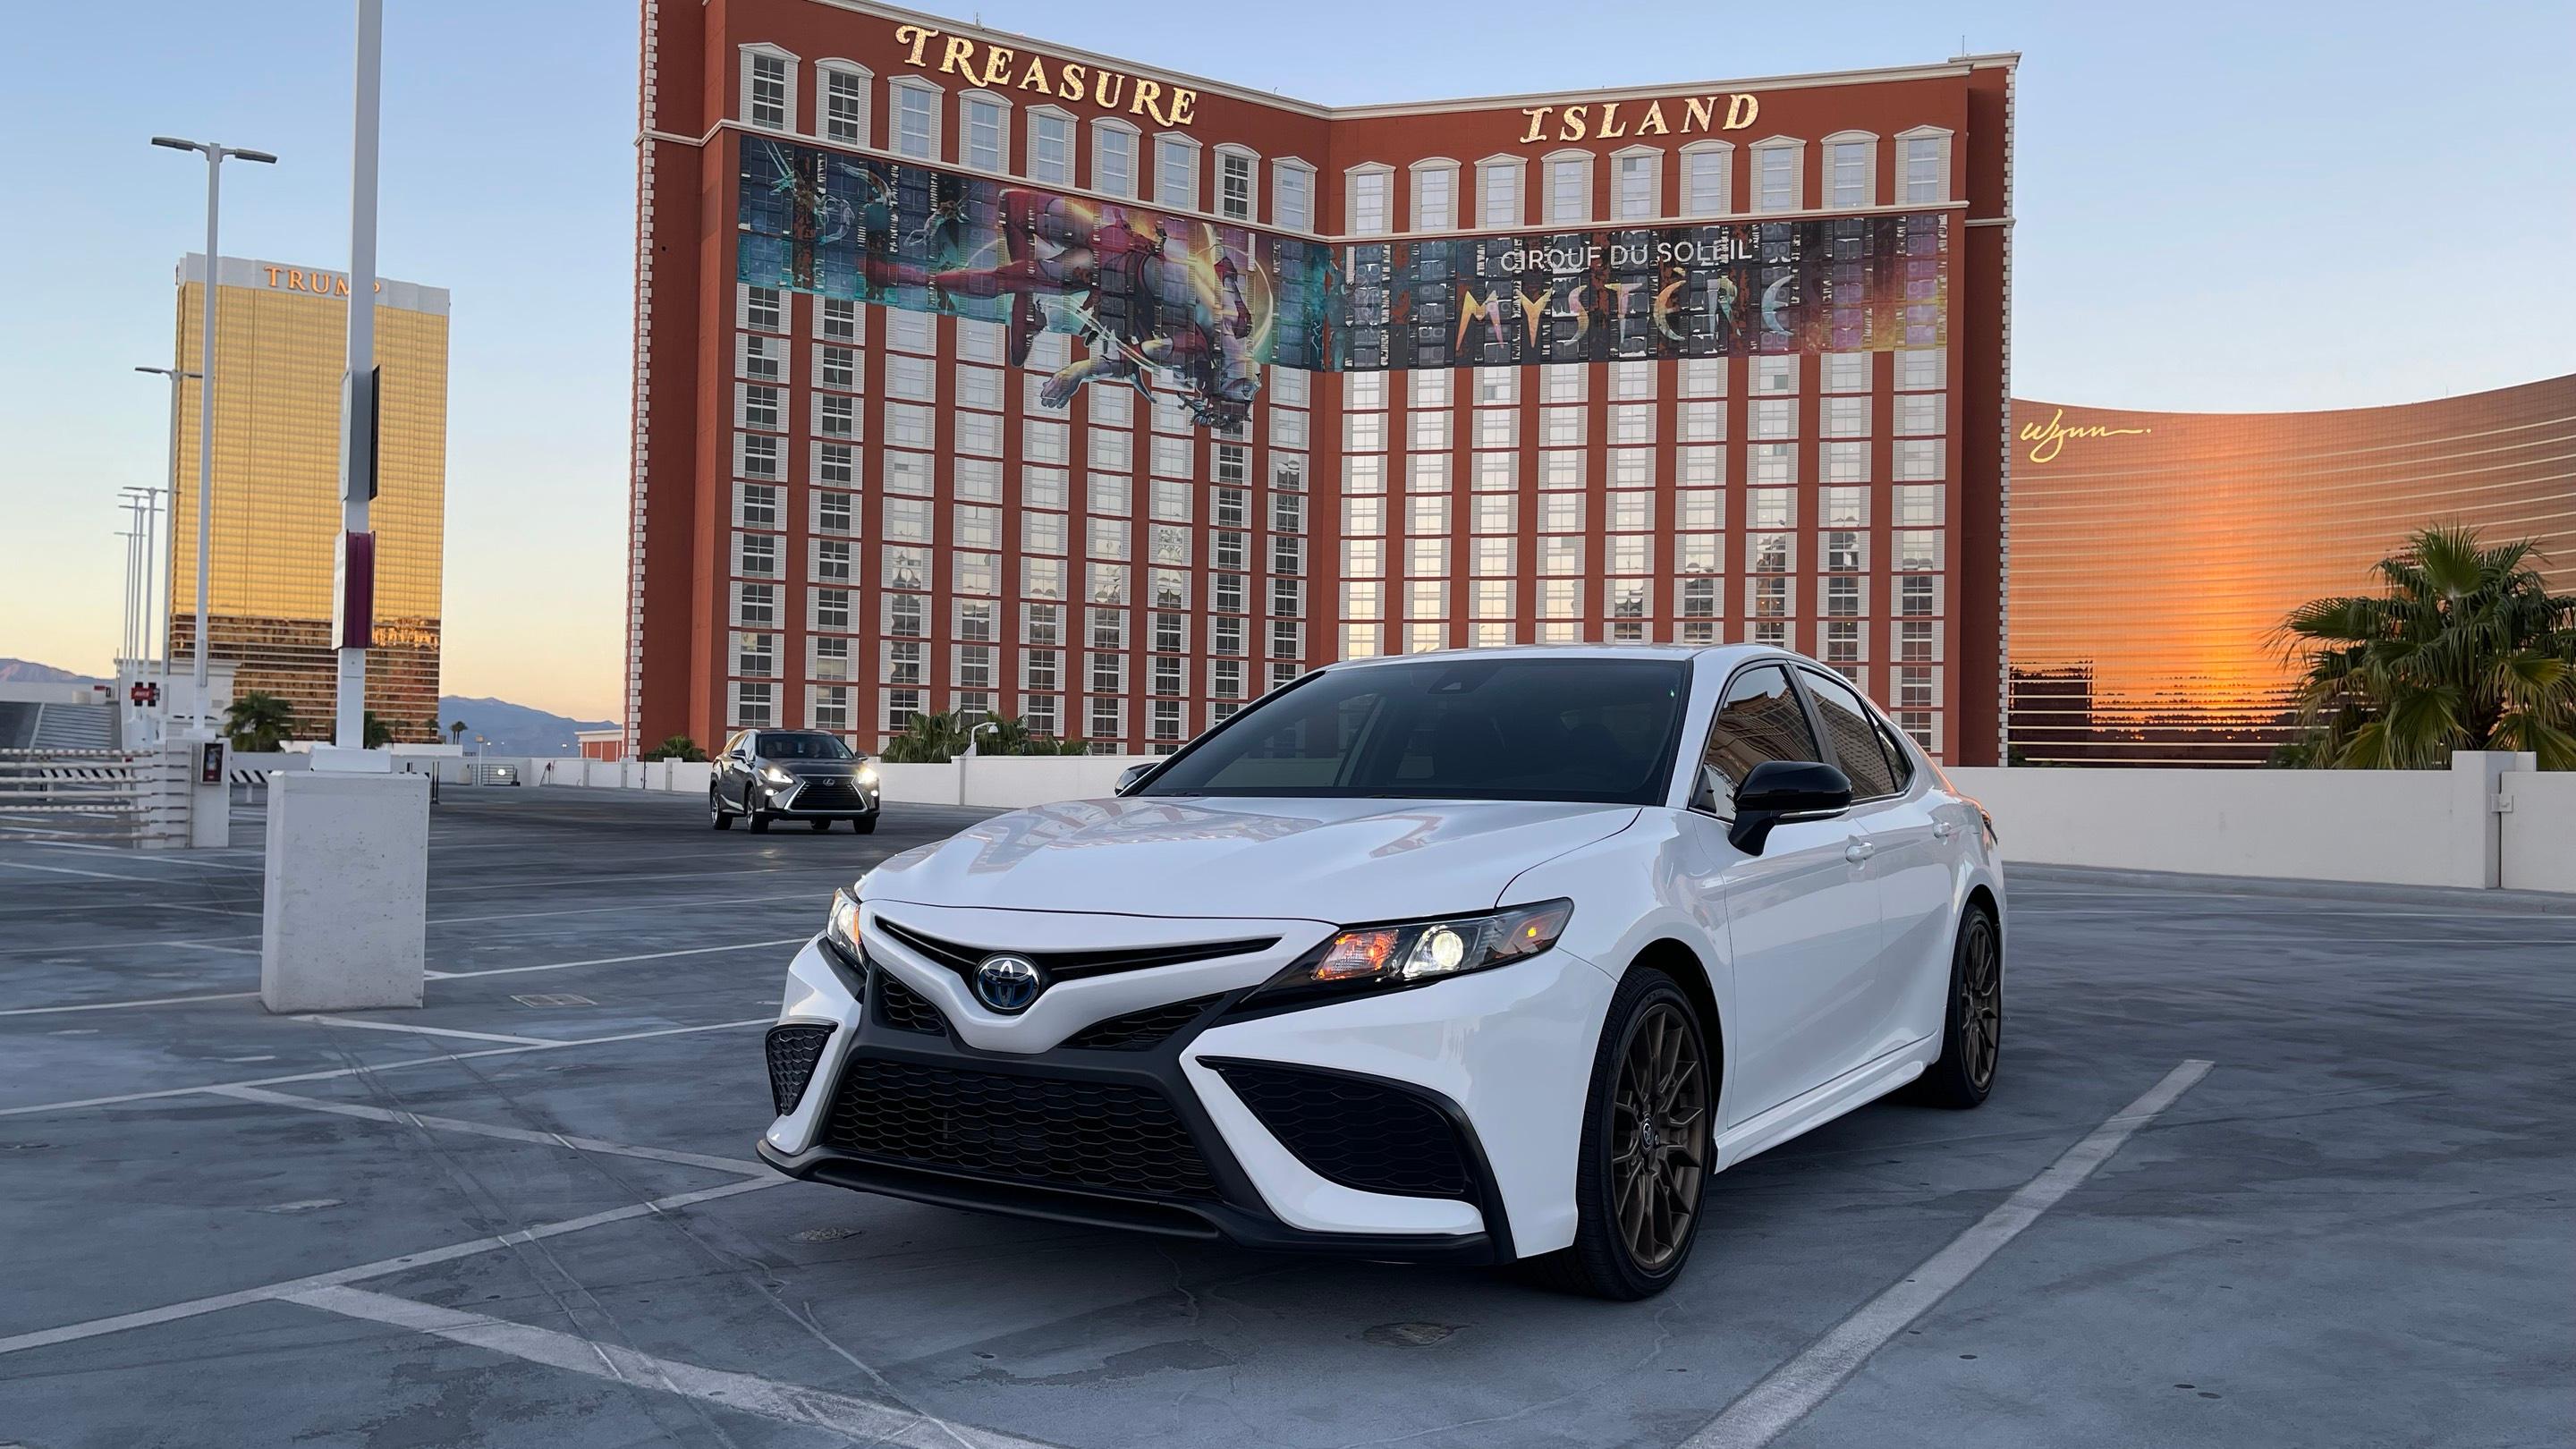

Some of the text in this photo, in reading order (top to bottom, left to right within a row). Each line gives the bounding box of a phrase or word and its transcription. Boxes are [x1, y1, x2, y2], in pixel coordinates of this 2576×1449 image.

[894, 25, 1198, 127] TREASURE
[1519, 94, 1759, 143] ISLAND
[1610, 244, 1648, 266] DU
[1657, 239, 1753, 263] SOLEIL
